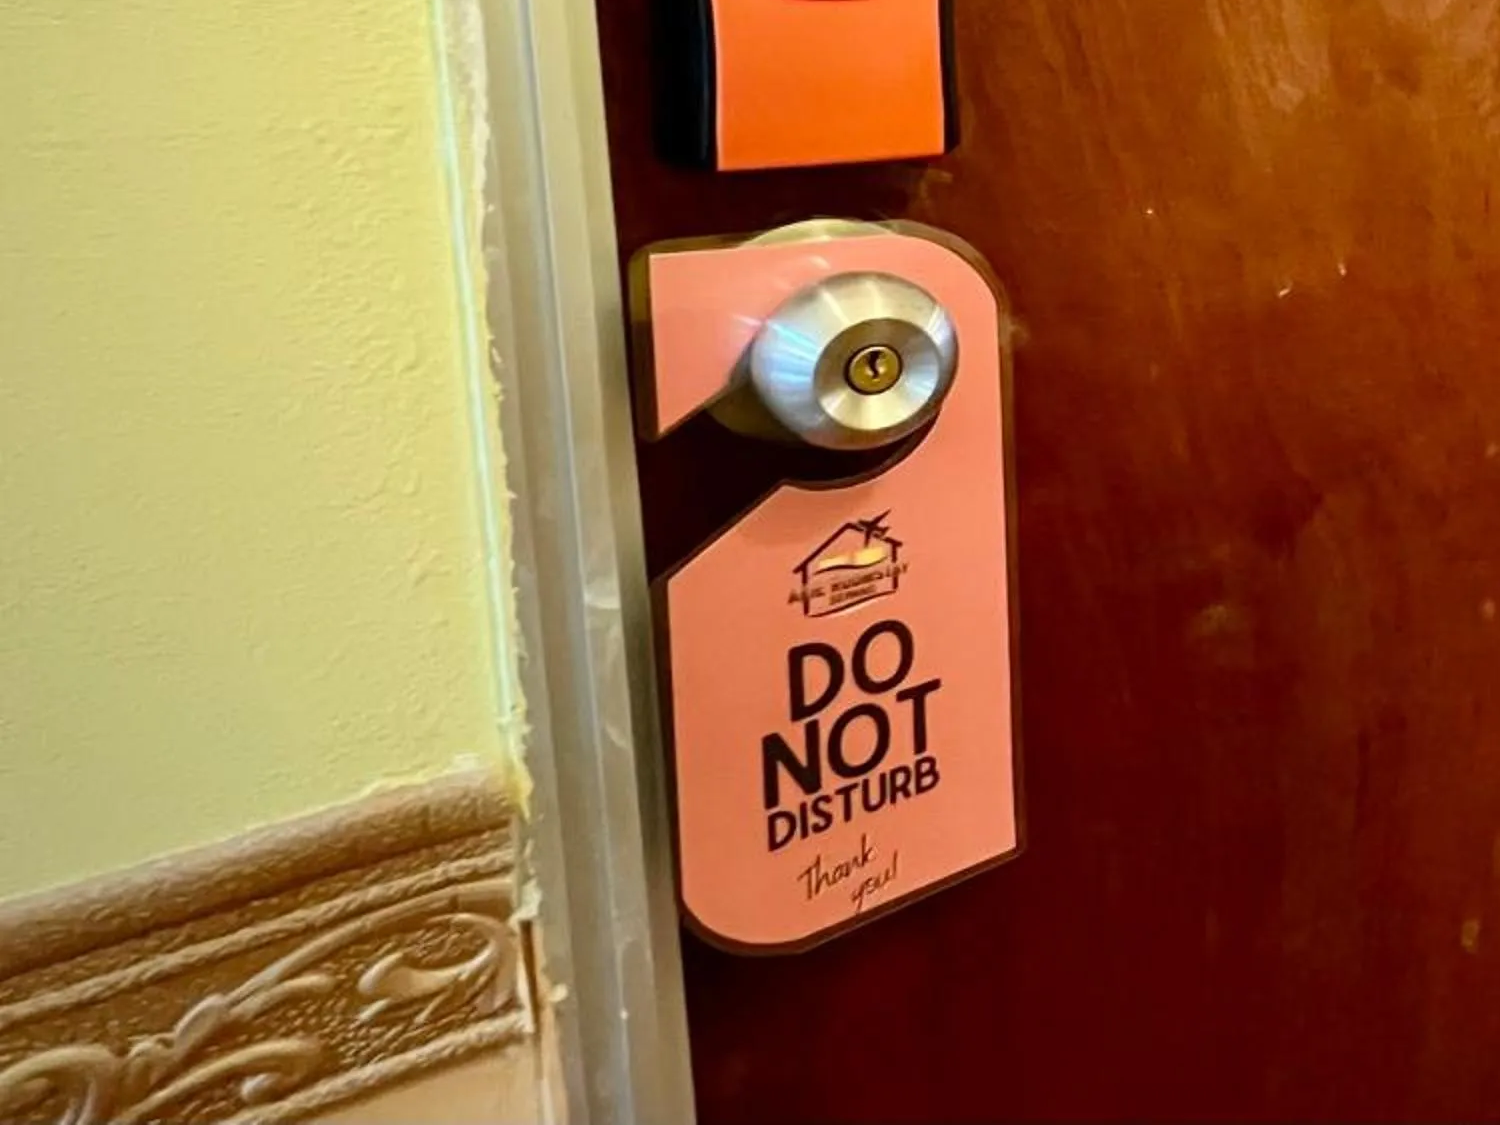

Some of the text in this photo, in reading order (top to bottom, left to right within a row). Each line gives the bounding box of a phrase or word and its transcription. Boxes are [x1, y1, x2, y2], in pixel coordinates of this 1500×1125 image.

[787, 619, 914, 722] DO
[761, 678, 941, 809] NOT
[766, 756, 940, 852] DISTURB
[797, 832, 874, 901] Thank
[851, 849, 898, 915] you!
